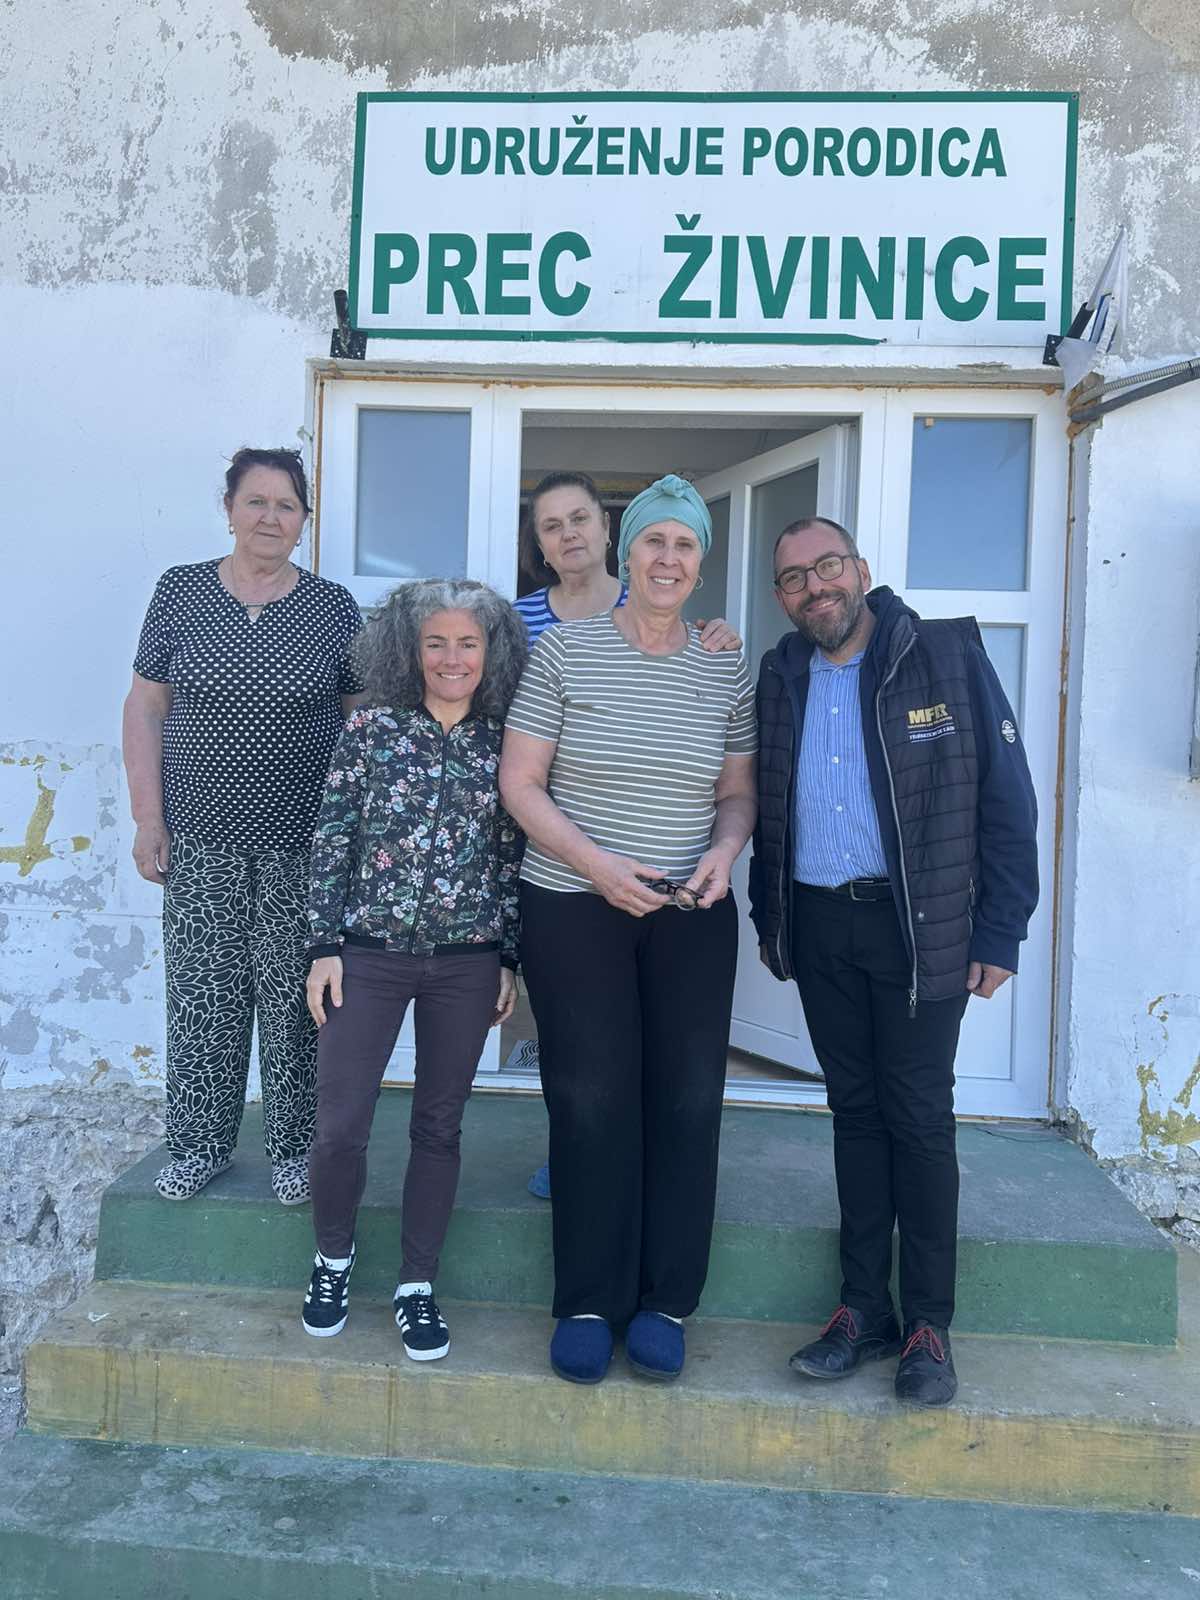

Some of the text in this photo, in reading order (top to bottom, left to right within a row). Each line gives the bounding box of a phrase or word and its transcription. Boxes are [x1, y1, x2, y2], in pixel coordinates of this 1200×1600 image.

[425, 114, 1007, 178] UDRUŽENJE PORODICA
[371, 213, 1047, 322] PREC ŽIVINICE
